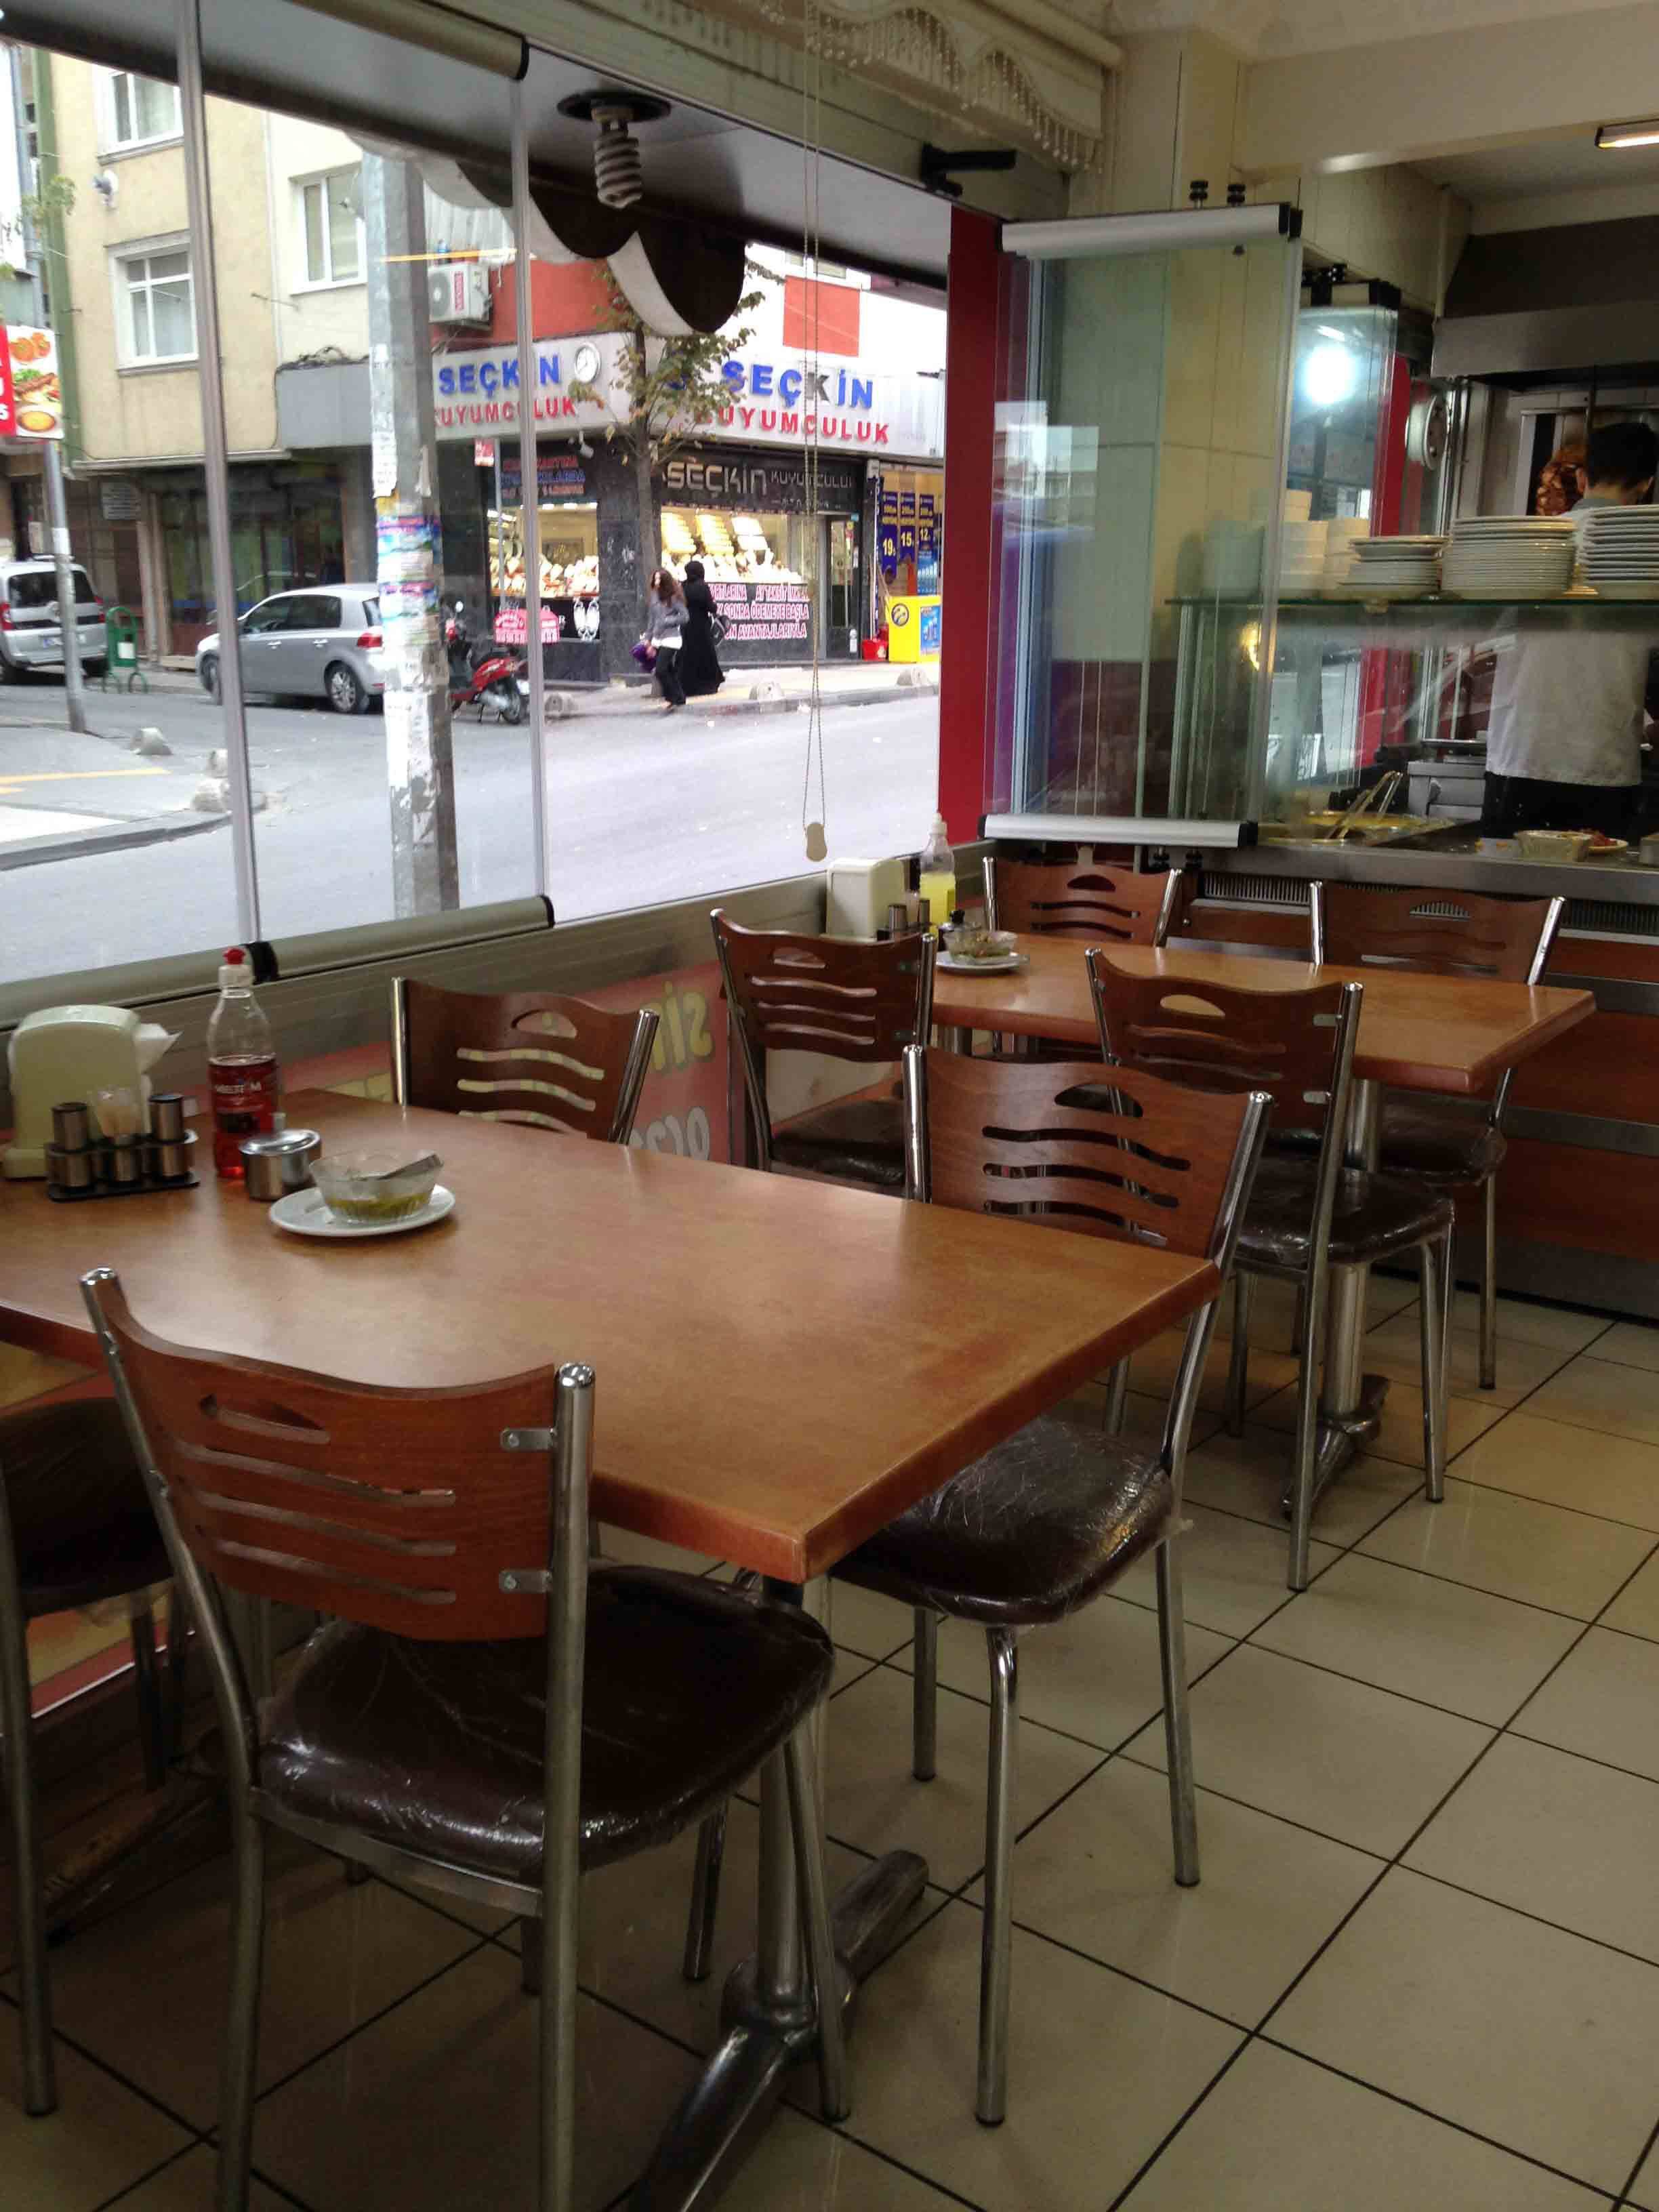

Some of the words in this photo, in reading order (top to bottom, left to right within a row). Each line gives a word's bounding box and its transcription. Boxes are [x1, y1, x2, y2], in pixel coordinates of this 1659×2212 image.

[438, 355, 560, 398] SEÇKN
[722, 361, 874, 409] SEÇKİN
[434, 396, 576, 428] UYUMCLUK
[697, 404, 890, 445] UYUMCULUK
[724, 602, 750, 620] SONRA
[750, 600, 785, 620] ÖDEMEYE
